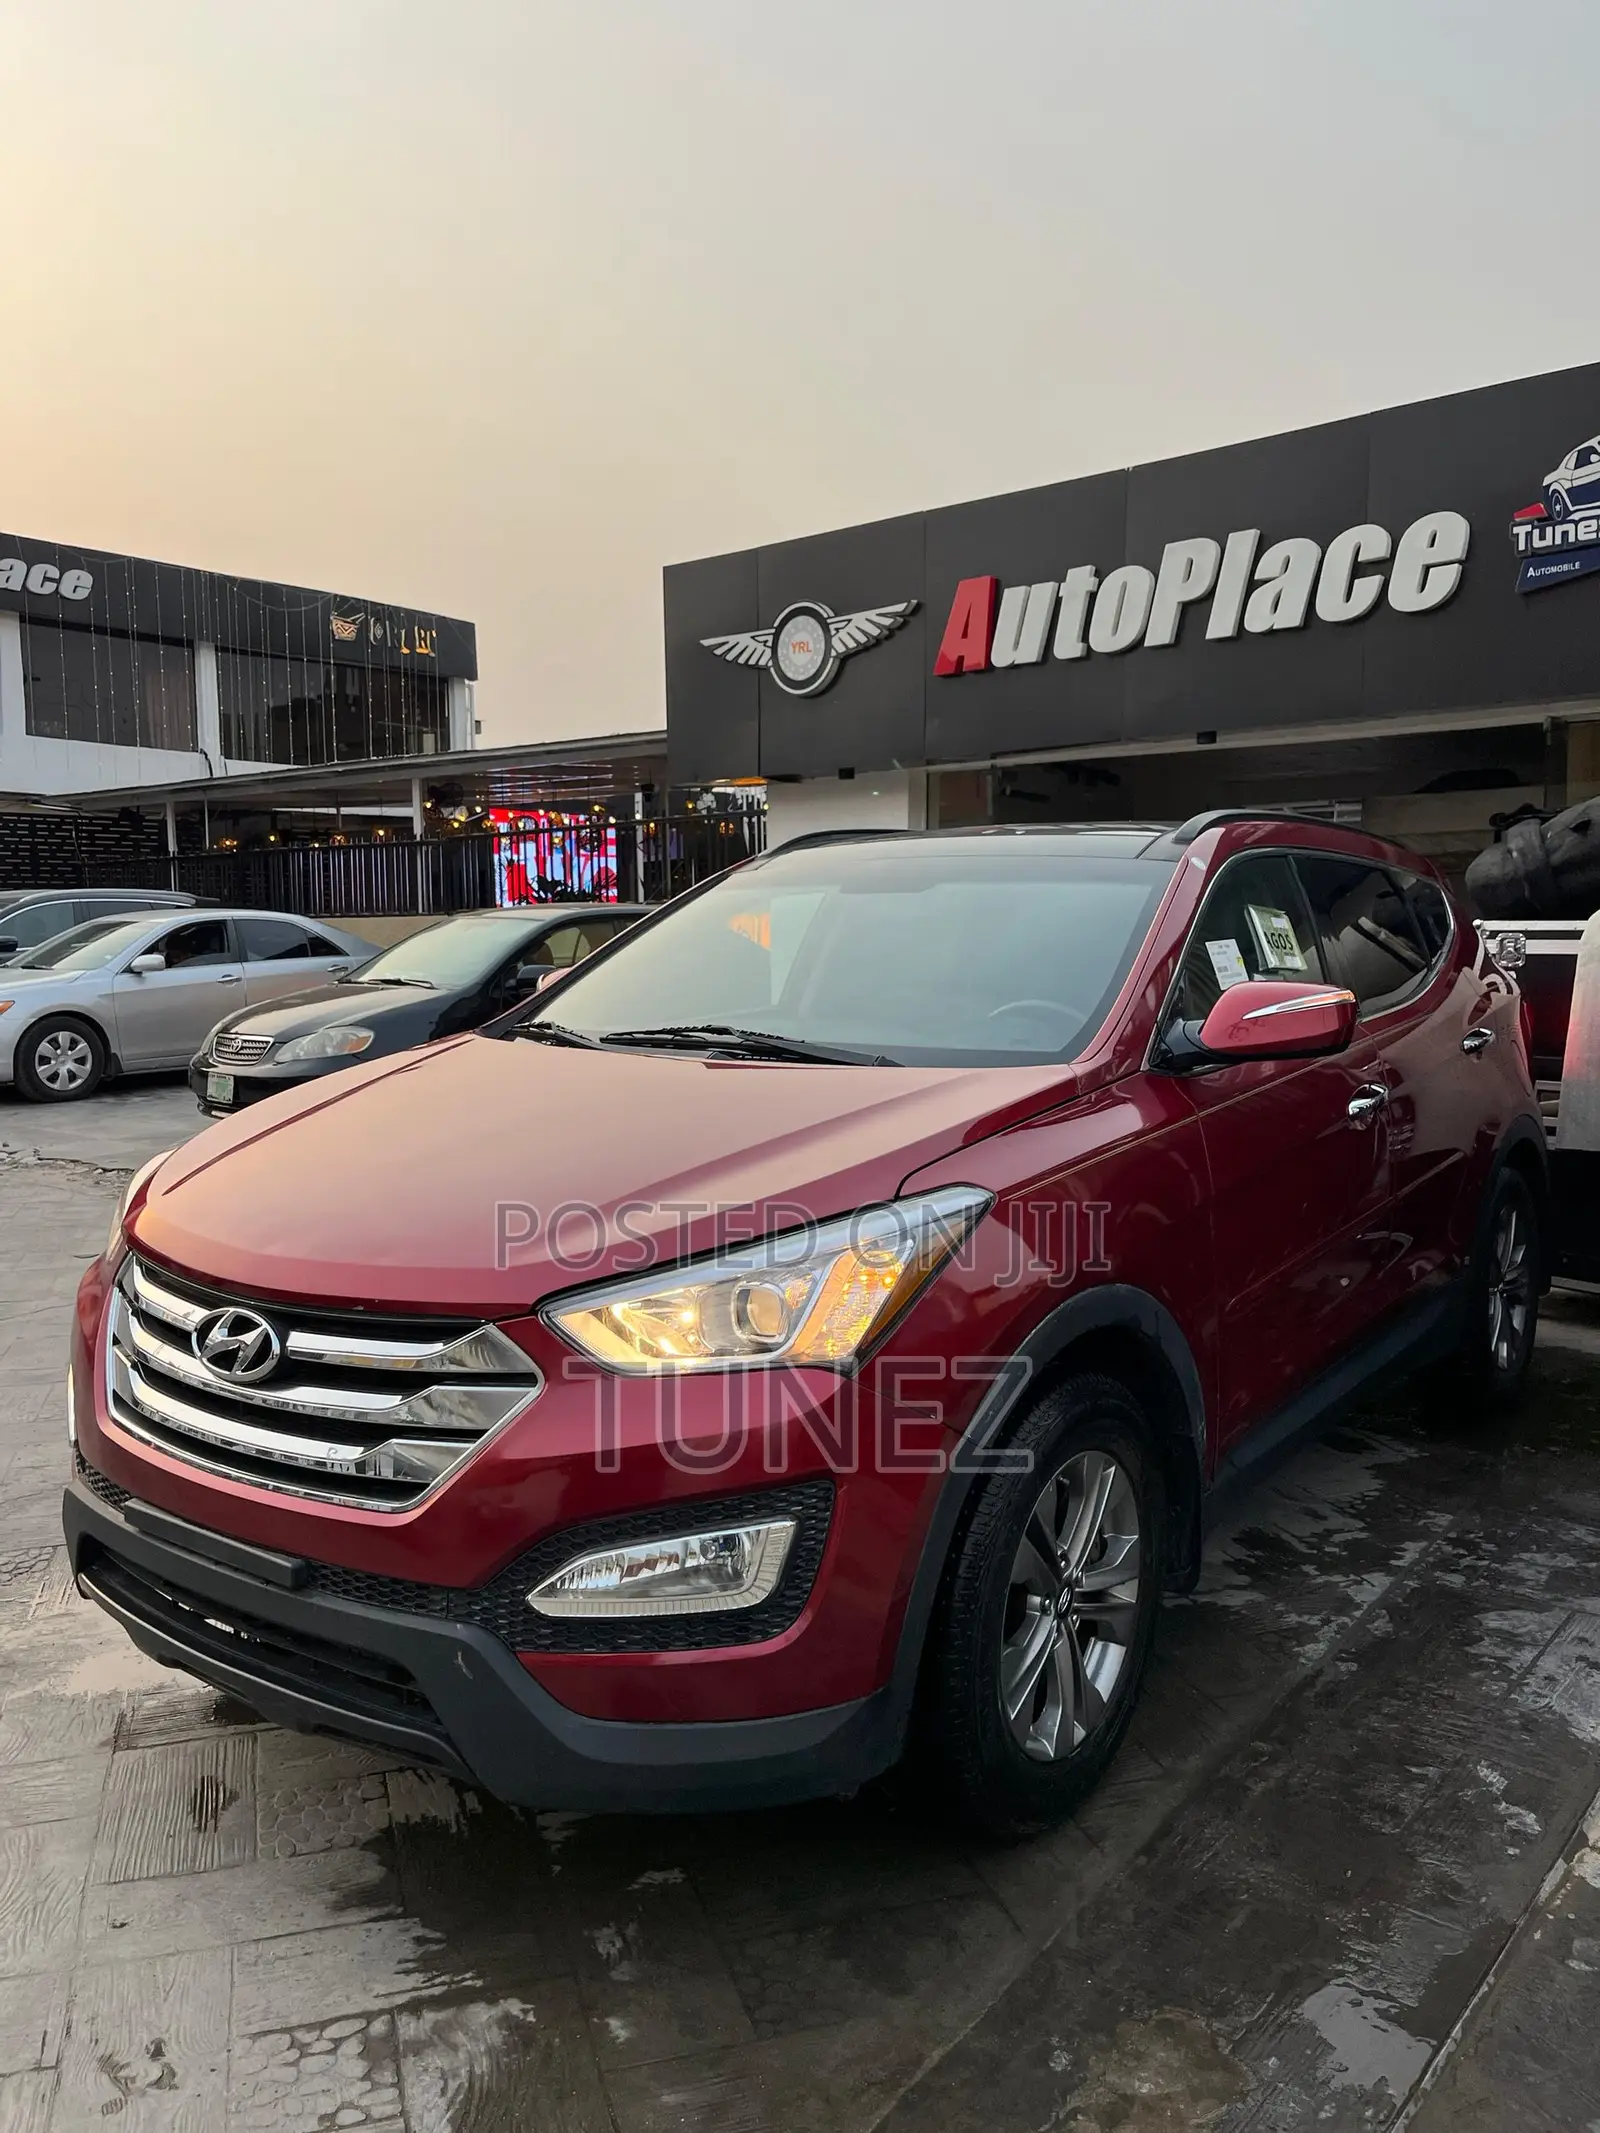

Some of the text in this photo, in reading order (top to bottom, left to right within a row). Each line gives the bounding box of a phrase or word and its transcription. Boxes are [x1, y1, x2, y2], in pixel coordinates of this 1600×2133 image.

[1512, 519, 1600, 551] Tune
[933, 510, 1471, 677] AutoPlace
[791, 641, 813, 655] YRL
